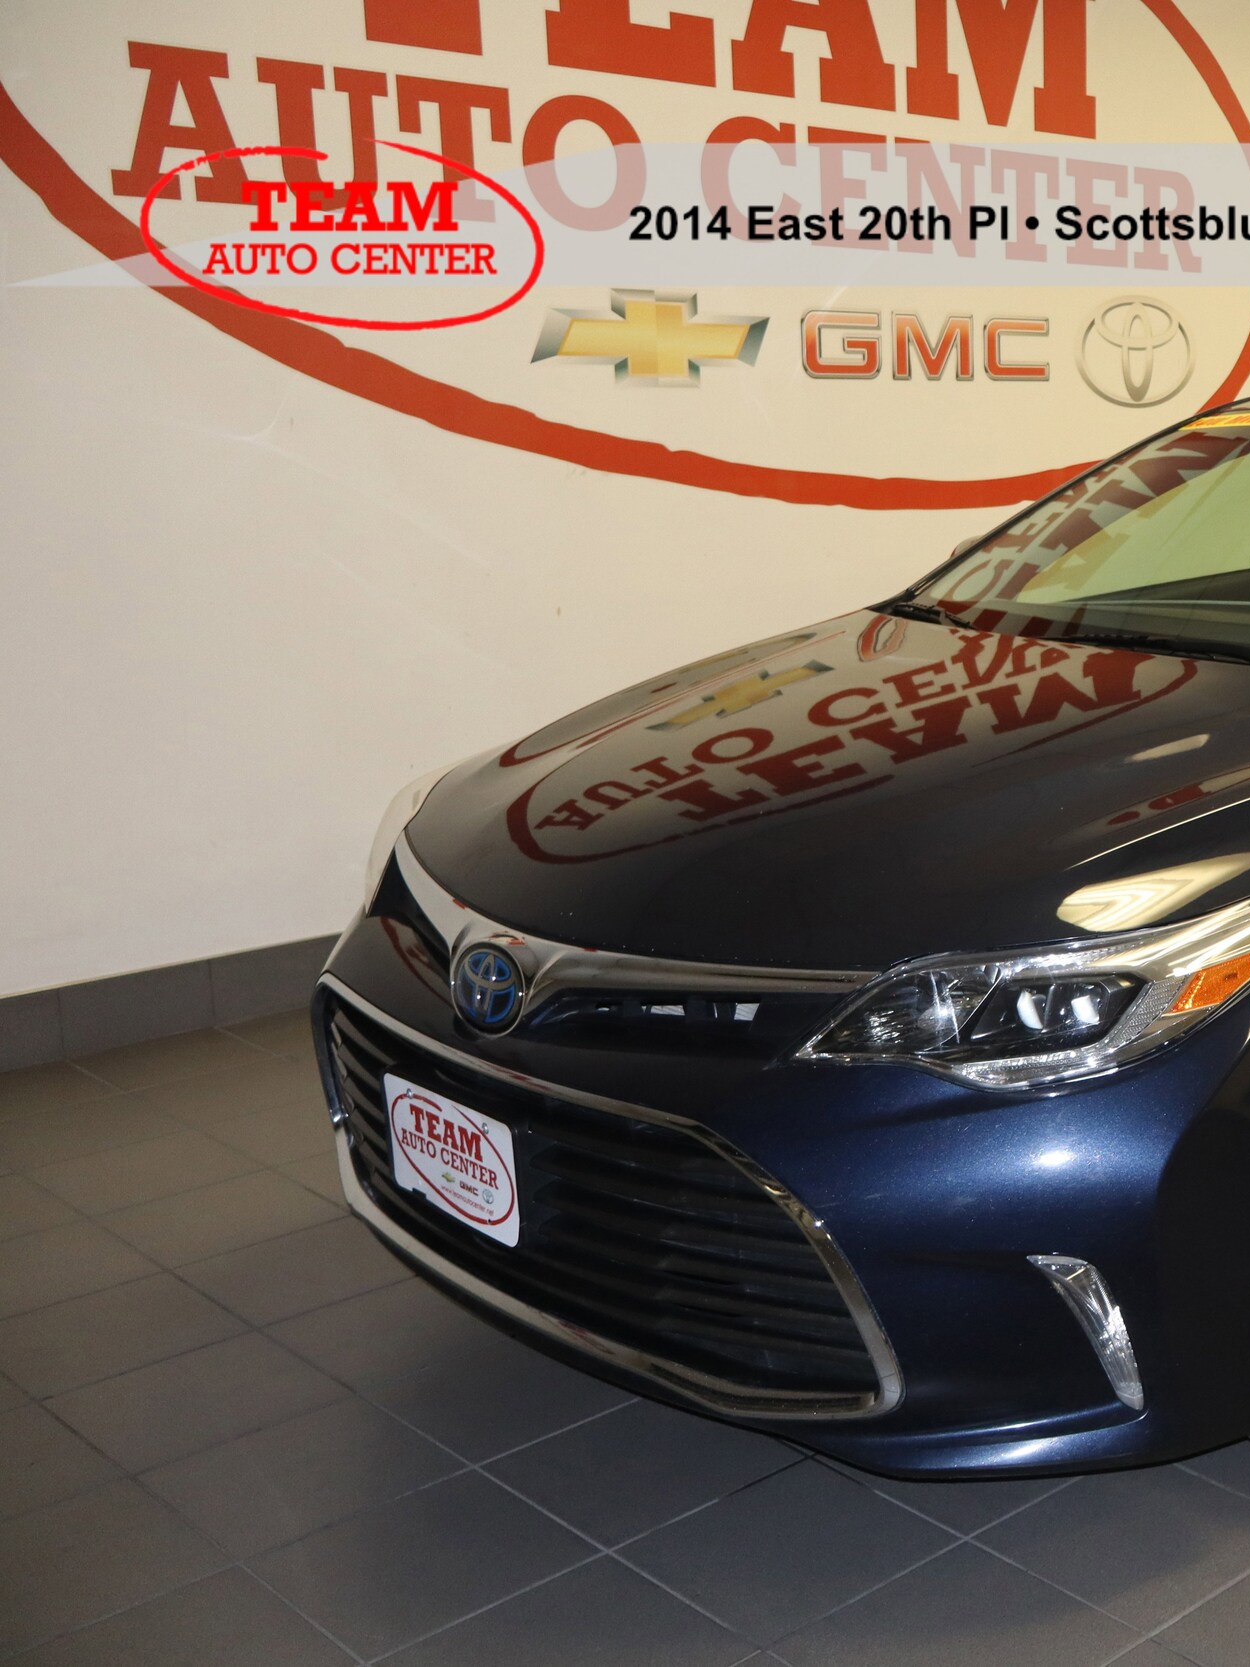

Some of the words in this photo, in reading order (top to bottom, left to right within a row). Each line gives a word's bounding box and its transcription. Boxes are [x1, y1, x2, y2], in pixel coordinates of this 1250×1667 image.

[700, 115, 1202, 273] CENTER
[801, 309, 1050, 382] GMC
[401, 1127, 437, 1159] AUTO
[440, 1147, 499, 1190] CENTER
[409, 1103, 483, 1162] TEAM
[459, 1180, 479, 1197] GMC
